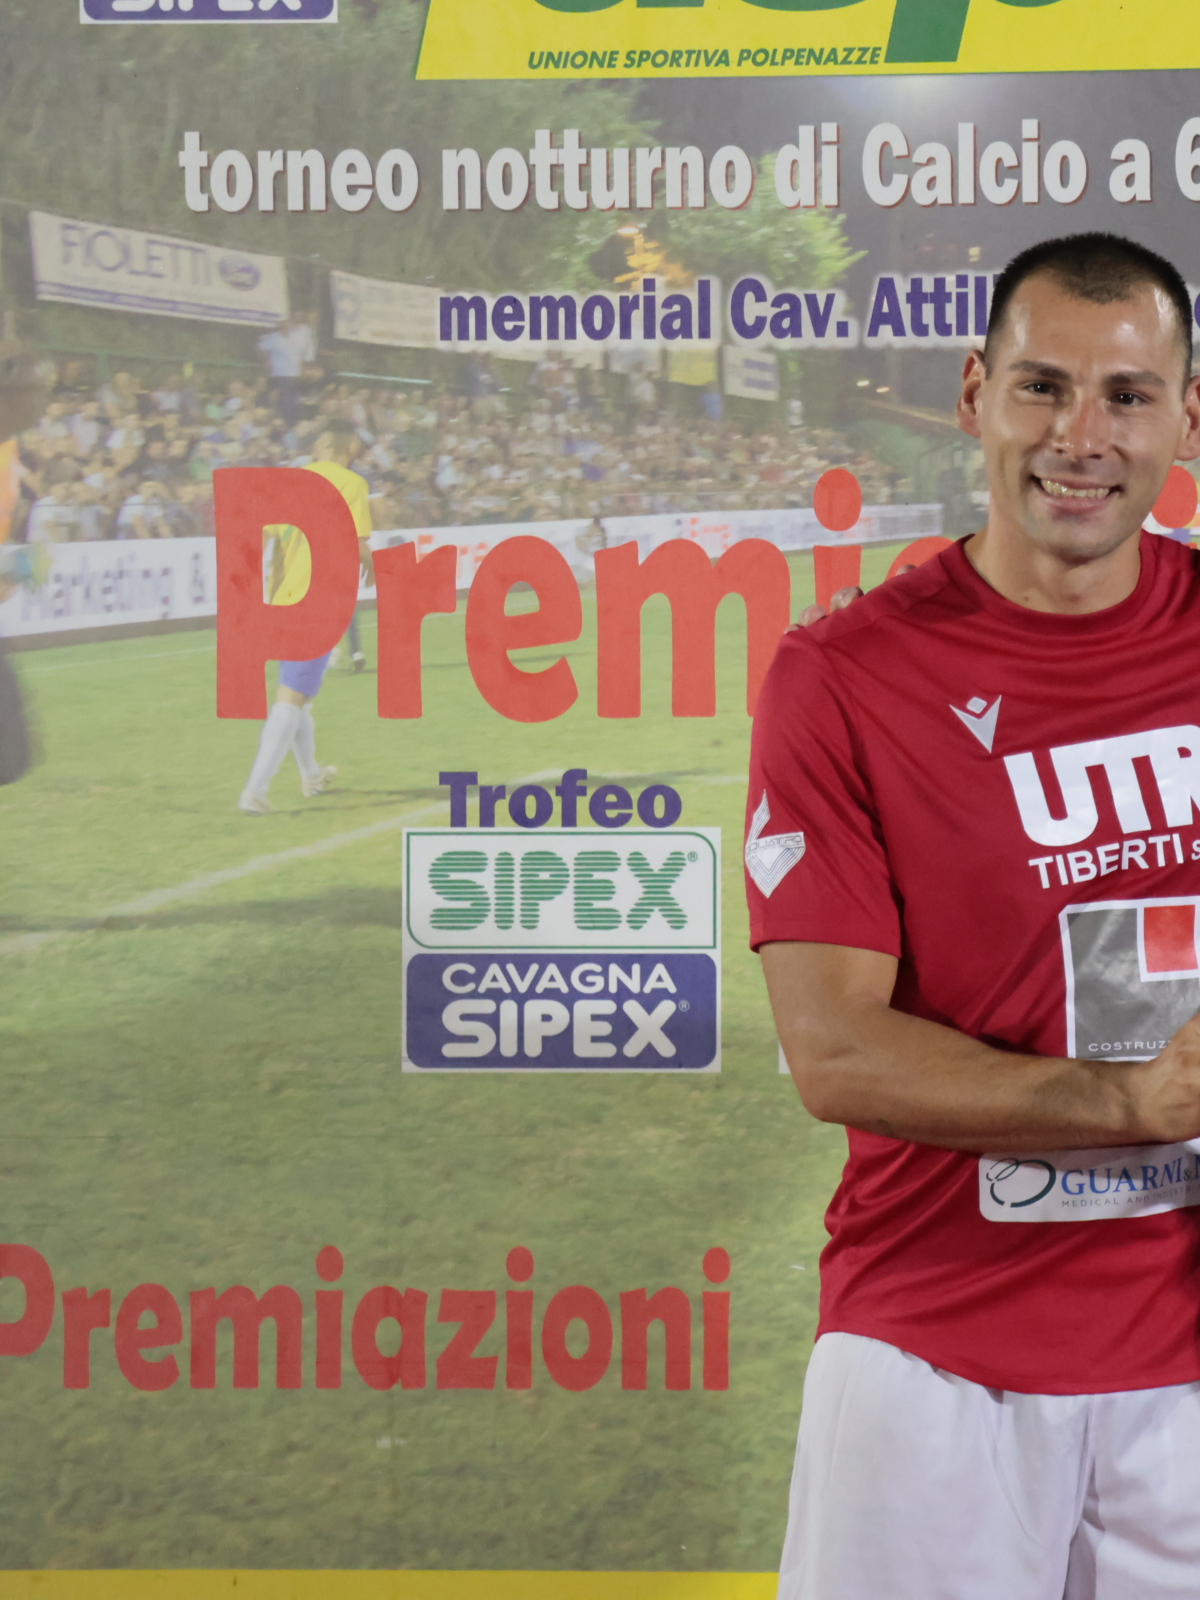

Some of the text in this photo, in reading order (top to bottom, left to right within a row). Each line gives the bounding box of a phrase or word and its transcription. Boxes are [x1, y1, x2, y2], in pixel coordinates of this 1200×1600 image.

[528, 47, 883, 70] UNIONE SPORTIVA POLPENAZZE
[179, 131, 420, 213] torneo
[441, 128, 754, 211] notturno
[774, 122, 841, 208] di
[862, 117, 1088, 208] Calcio
[1109, 138, 1153, 203] a
[439, 278, 711, 341] memorial
[730, 277, 849, 339] Cav.
[867, 274, 999, 337] Attil
[439, 768, 683, 828] Trofeo
[1028, 833, 1184, 889] TIBERTI
[442, 962, 677, 994] CAVAGNA
[1088, 1040, 1171, 1052] COSTRUZ
[1062, 1198, 1120, 1208] MEDICAL
[1127, 1195, 1150, 1204] AND
